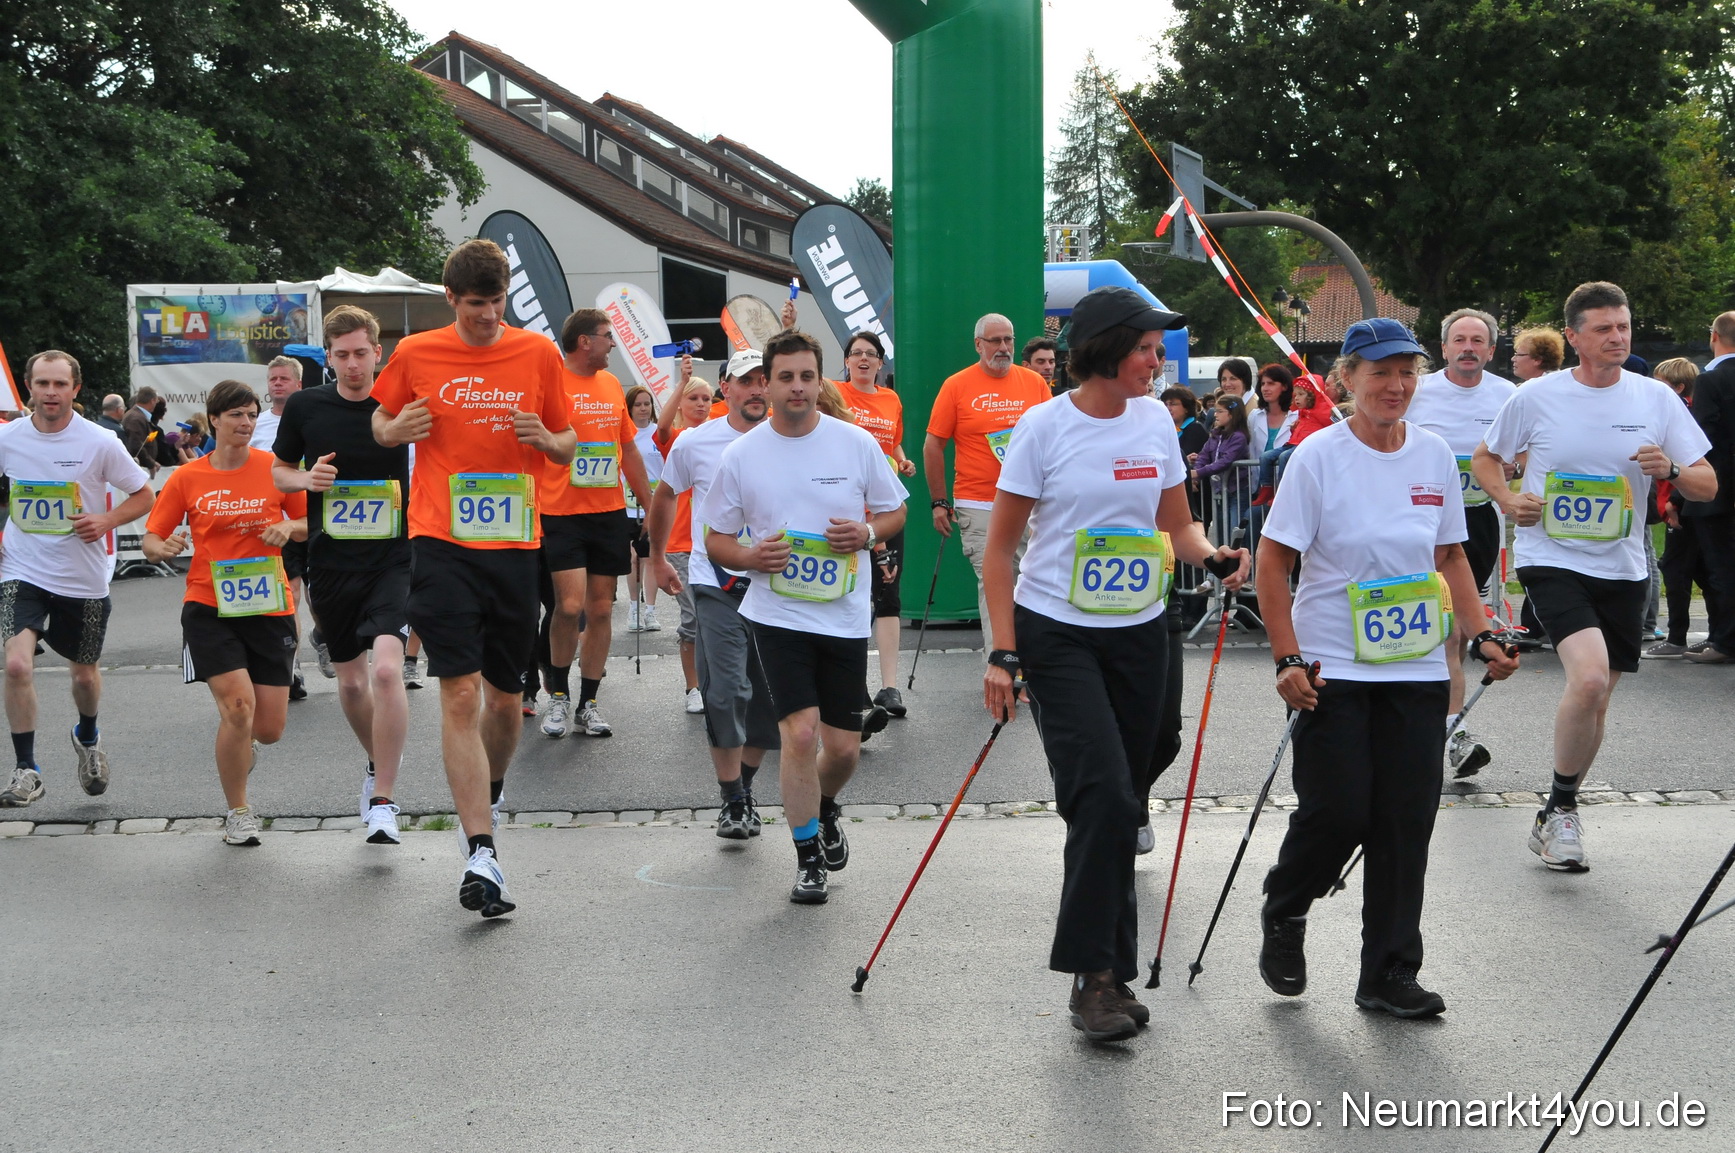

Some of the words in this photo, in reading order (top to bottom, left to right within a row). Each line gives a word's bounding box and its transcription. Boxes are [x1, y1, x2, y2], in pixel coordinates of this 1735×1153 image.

[143, 312, 207, 334] TLA
[216, 321, 292, 344] Logistics
[454, 388, 524, 401] Fischer
[573, 401, 614, 410] Fischer
[981, 399, 1025, 408] Fischer
[855, 411, 894, 426] Fischer
[576, 457, 613, 476] 977
[1121, 469, 1153, 478] Apotheke
[18, 499, 65, 520] 701
[207, 497, 267, 510] Fischer
[213, 508, 262, 516] AUTOMOBILE
[331, 500, 385, 523] 247
[458, 496, 511, 524] 961
[1553, 495, 1613, 524] 697
[1562, 522, 1591, 531] Manfred
[781, 553, 838, 586] 698
[1082, 557, 1150, 592] 629
[221, 576, 271, 602] 954
[787, 581, 809, 590] Stefan
[1095, 593, 1116, 601] Anke
[1363, 602, 1431, 643] 634
[1379, 641, 1403, 651] Helga
